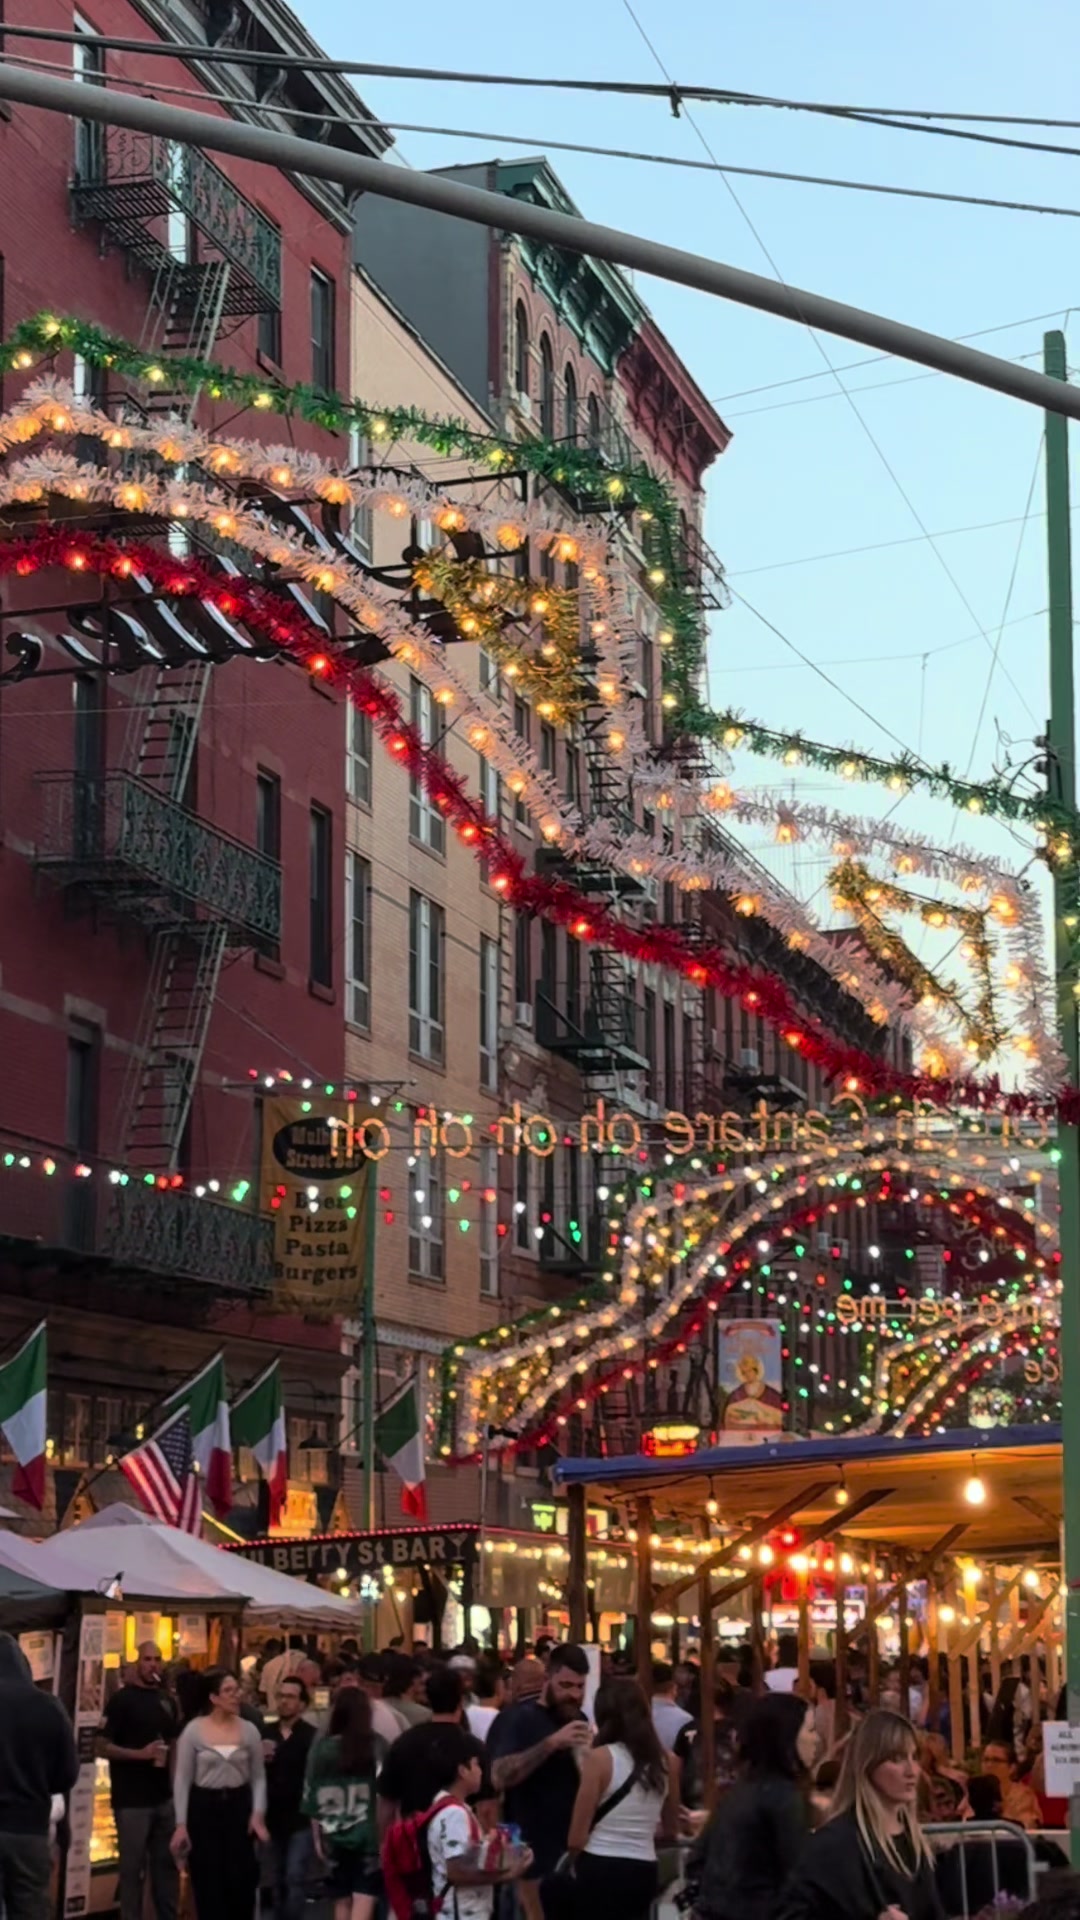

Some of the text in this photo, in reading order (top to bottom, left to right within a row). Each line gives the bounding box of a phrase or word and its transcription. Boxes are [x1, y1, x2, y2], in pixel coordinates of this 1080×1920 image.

[295, 1191, 344, 1209] Ber
[289, 1215, 349, 1234] Pizza
[285, 1239, 350, 1257] Pasta
[273, 1262, 358, 1285] Burgers
[358, 1540, 386, 1564] St
[392, 1536, 446, 1562] BAR
